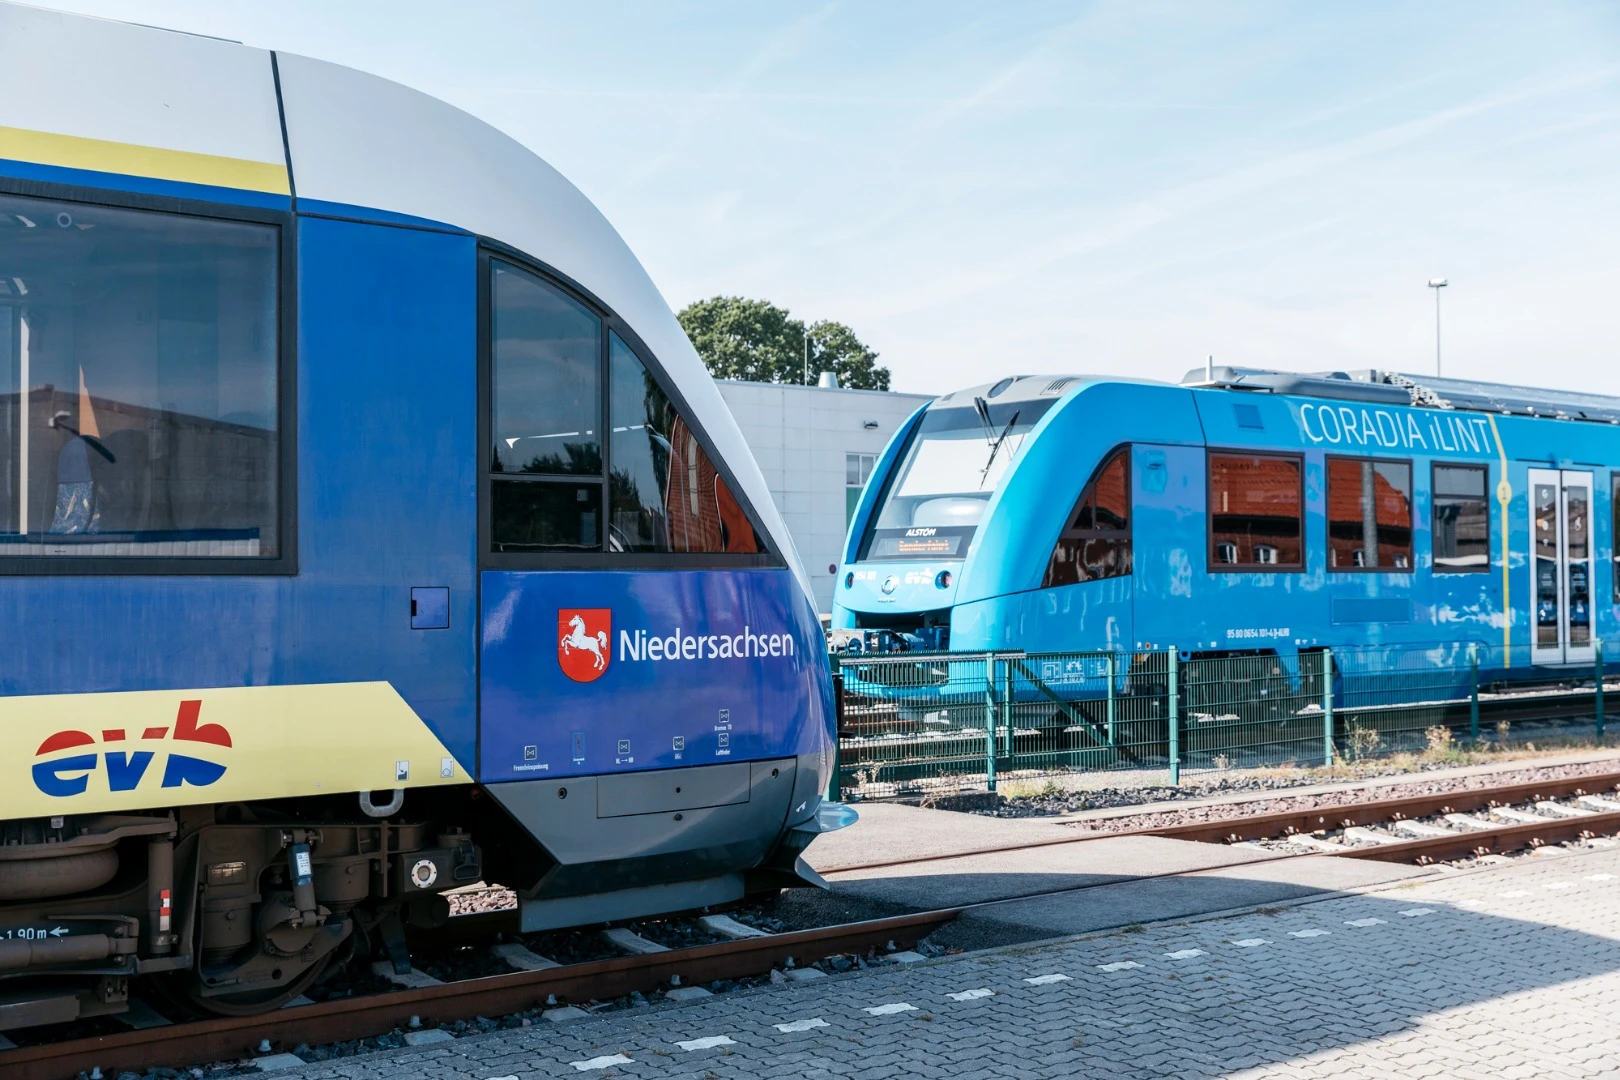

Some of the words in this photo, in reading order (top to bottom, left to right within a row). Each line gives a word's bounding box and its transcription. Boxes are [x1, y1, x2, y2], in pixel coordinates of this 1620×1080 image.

[1300, 403, 1428, 450] CORADIA
[1426, 412, 1492, 454] iLINT
[905, 528, 937, 537] ALSTOM
[619, 626, 794, 662] Niedersachsen
[31, 699, 233, 797] evb
